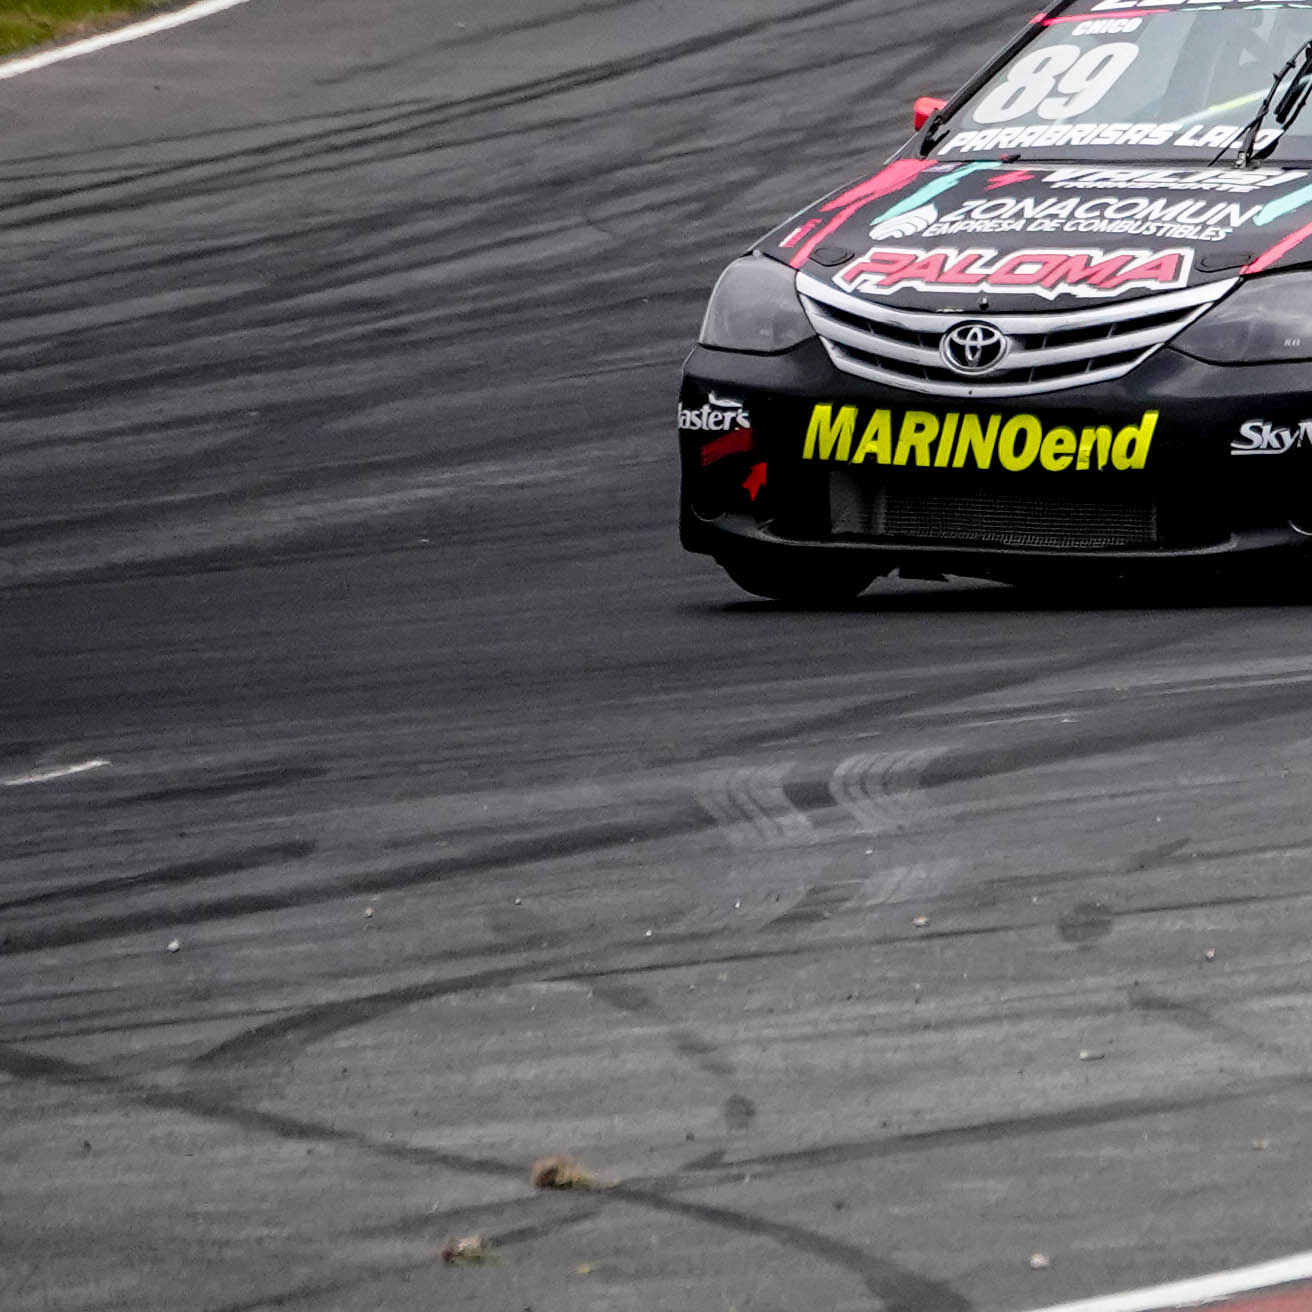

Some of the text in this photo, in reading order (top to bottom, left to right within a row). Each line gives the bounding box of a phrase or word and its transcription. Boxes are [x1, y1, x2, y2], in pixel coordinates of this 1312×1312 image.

[1071, 17, 1141, 38] CHICO
[971, 41, 1141, 124] 89
[940, 121, 1178, 157] PARABRISAS
[946, 197, 1265, 228] ZONACOMUN
[923, 219, 1235, 242] EMPRESA DE COMBUSTIBLES
[834, 247, 1195, 300] PALOMA
[678, 400, 752, 431] aster's
[802, 402, 1160, 472] MARINOend
